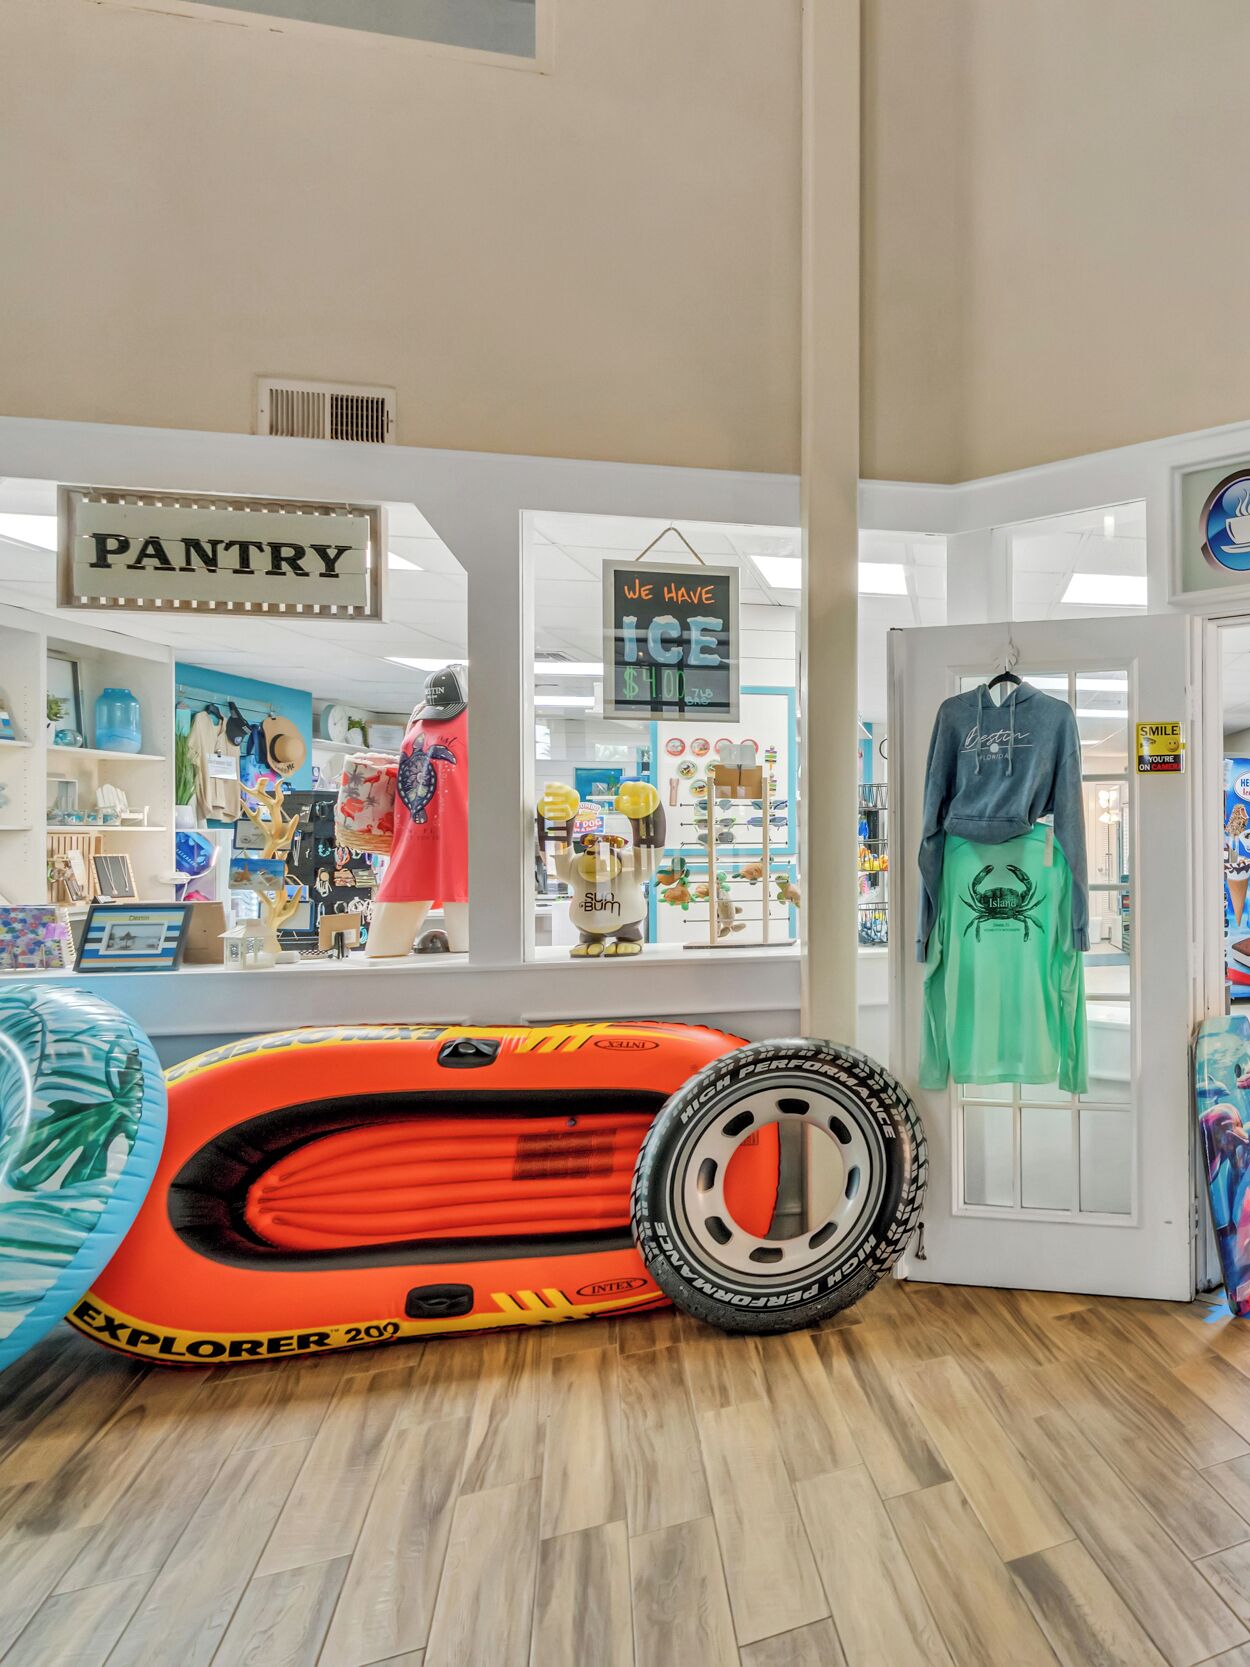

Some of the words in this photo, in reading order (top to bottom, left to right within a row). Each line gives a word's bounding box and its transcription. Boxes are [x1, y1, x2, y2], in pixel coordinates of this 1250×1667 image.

[89, 532, 353, 579] PANTRY
[624, 578, 654, 600] WE
[664, 582, 716, 605] HAVE
[622, 614, 724, 667] ICE
[1139, 763, 1151, 771] ON
[1149, 755, 1175, 763] YOU'RE
[989, 897, 1017, 908] Island
[680, 1076, 731, 1124] HIGH
[738, 1058, 897, 1139] PERFORMANCE
[654, 1221, 819, 1307] PERFORMANCE
[827, 1234, 878, 1288] HIGH
[591, 1280, 634, 1294] INTEX
[73, 1300, 331, 1358] EXPLORER
[344, 1321, 400, 1343] 200
